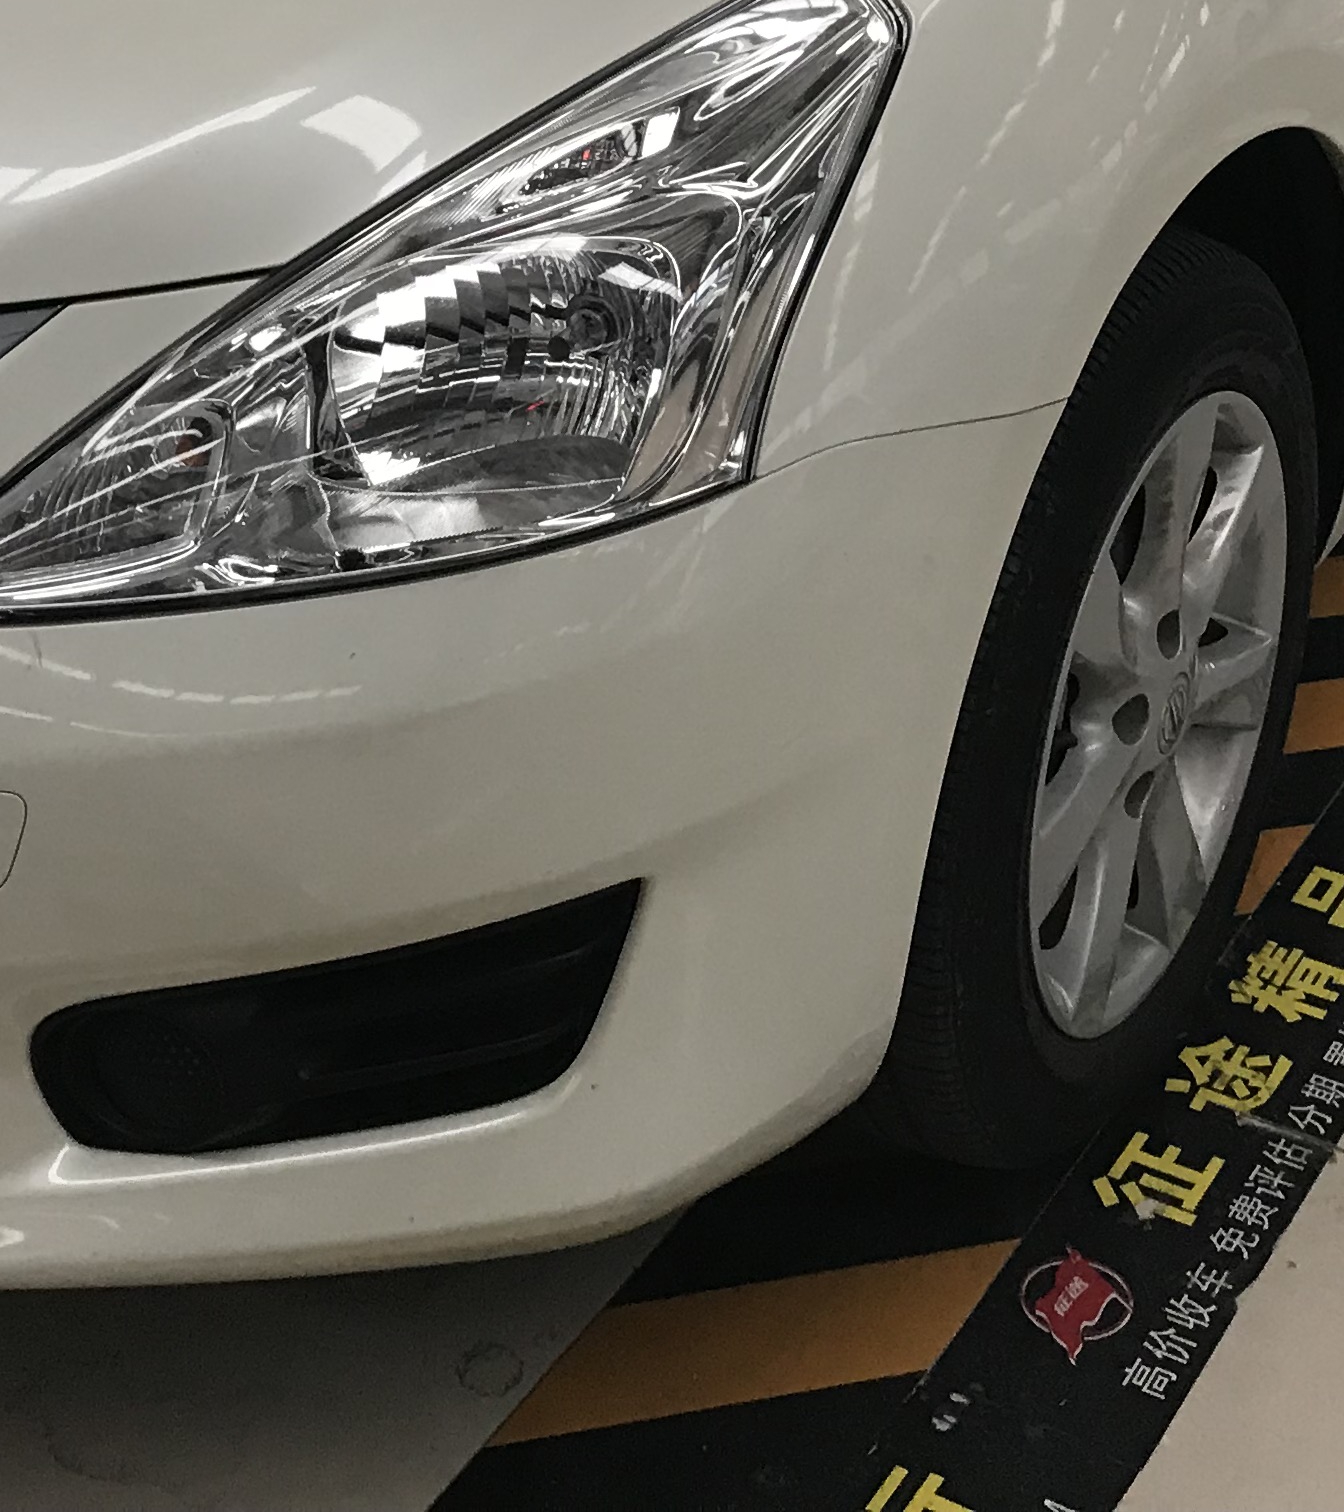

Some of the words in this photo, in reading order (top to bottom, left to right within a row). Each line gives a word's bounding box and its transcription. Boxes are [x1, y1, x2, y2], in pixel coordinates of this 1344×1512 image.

[1121, 1261, 1234, 1399] 高价收车
[1209, 1136, 1315, 1260] 免费评估
